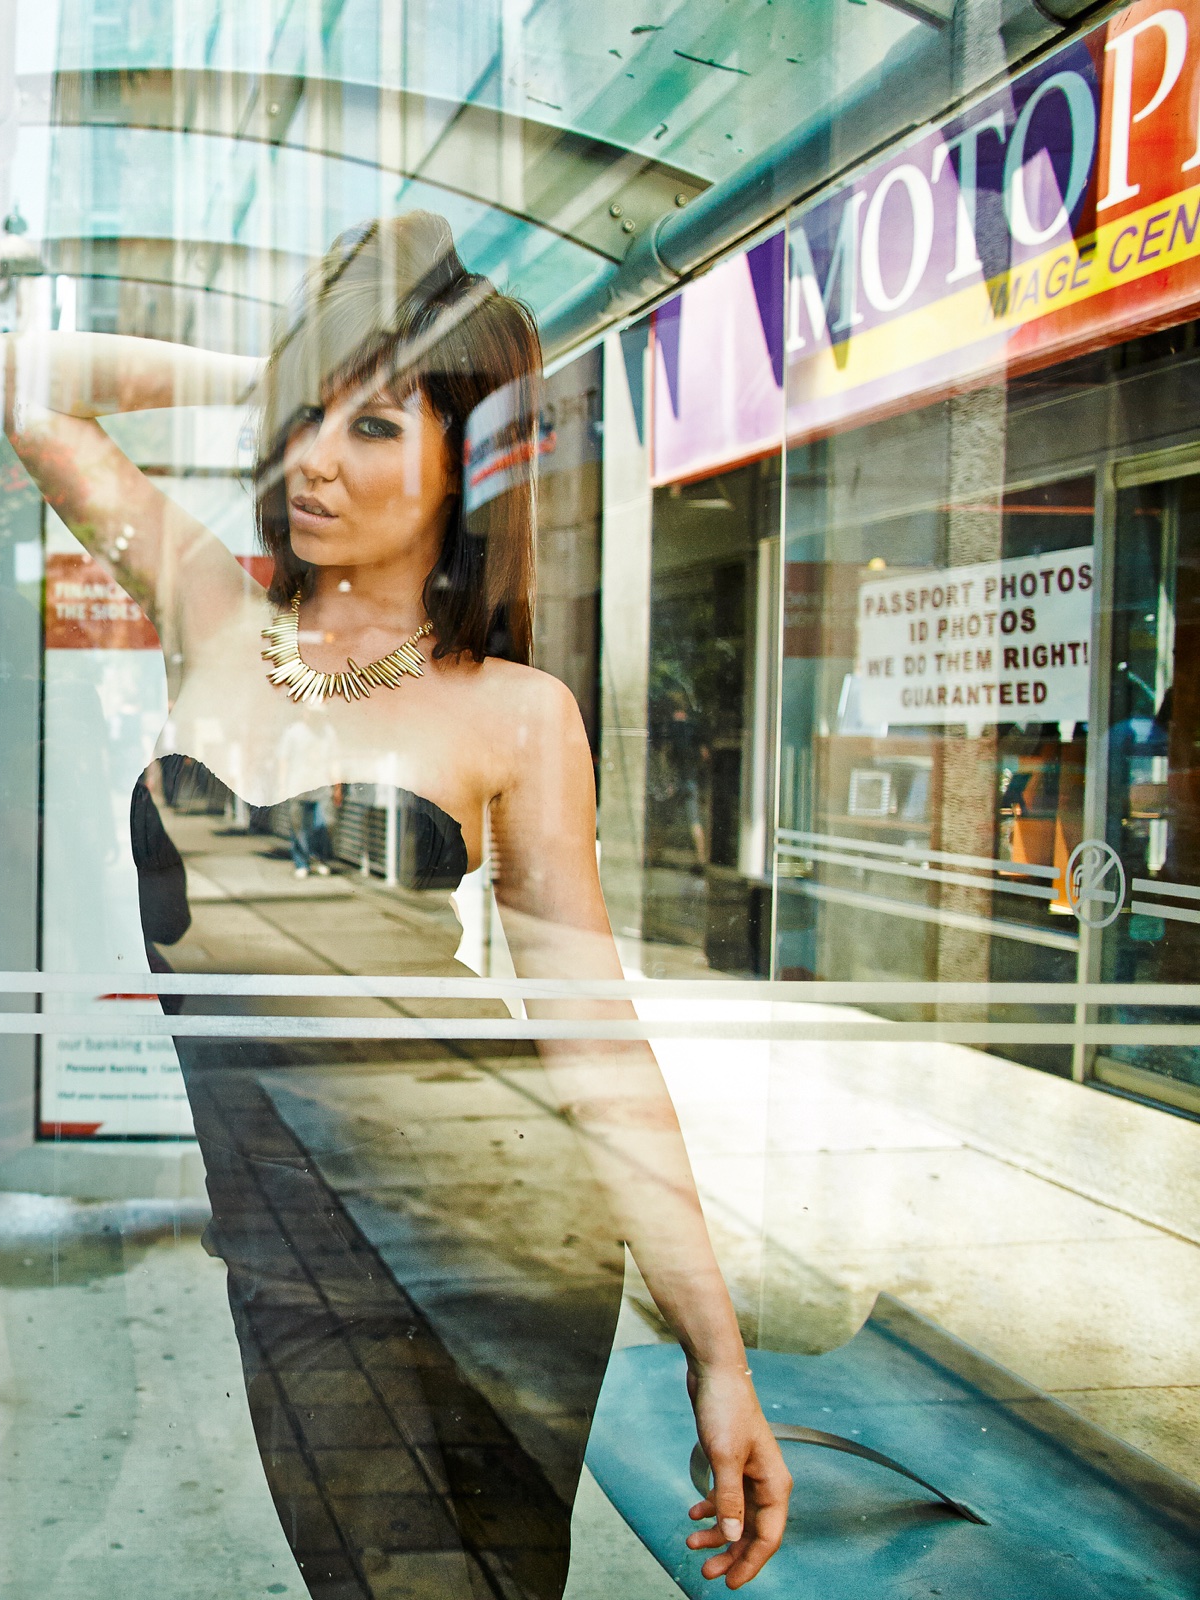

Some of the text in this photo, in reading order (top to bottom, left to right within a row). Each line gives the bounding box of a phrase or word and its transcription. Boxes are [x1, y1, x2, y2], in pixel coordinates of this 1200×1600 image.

[785, 8, 1200, 352] MOTOP
[864, 564, 1093, 616] PASSPORT PHOTOS
[55, 603, 86, 620] THE
[909, 608, 1037, 643] ID PHOTOS
[866, 642, 1089, 678] WE DO THEM RIGHT!
[901, 681, 1048, 708] GUARANTEED
